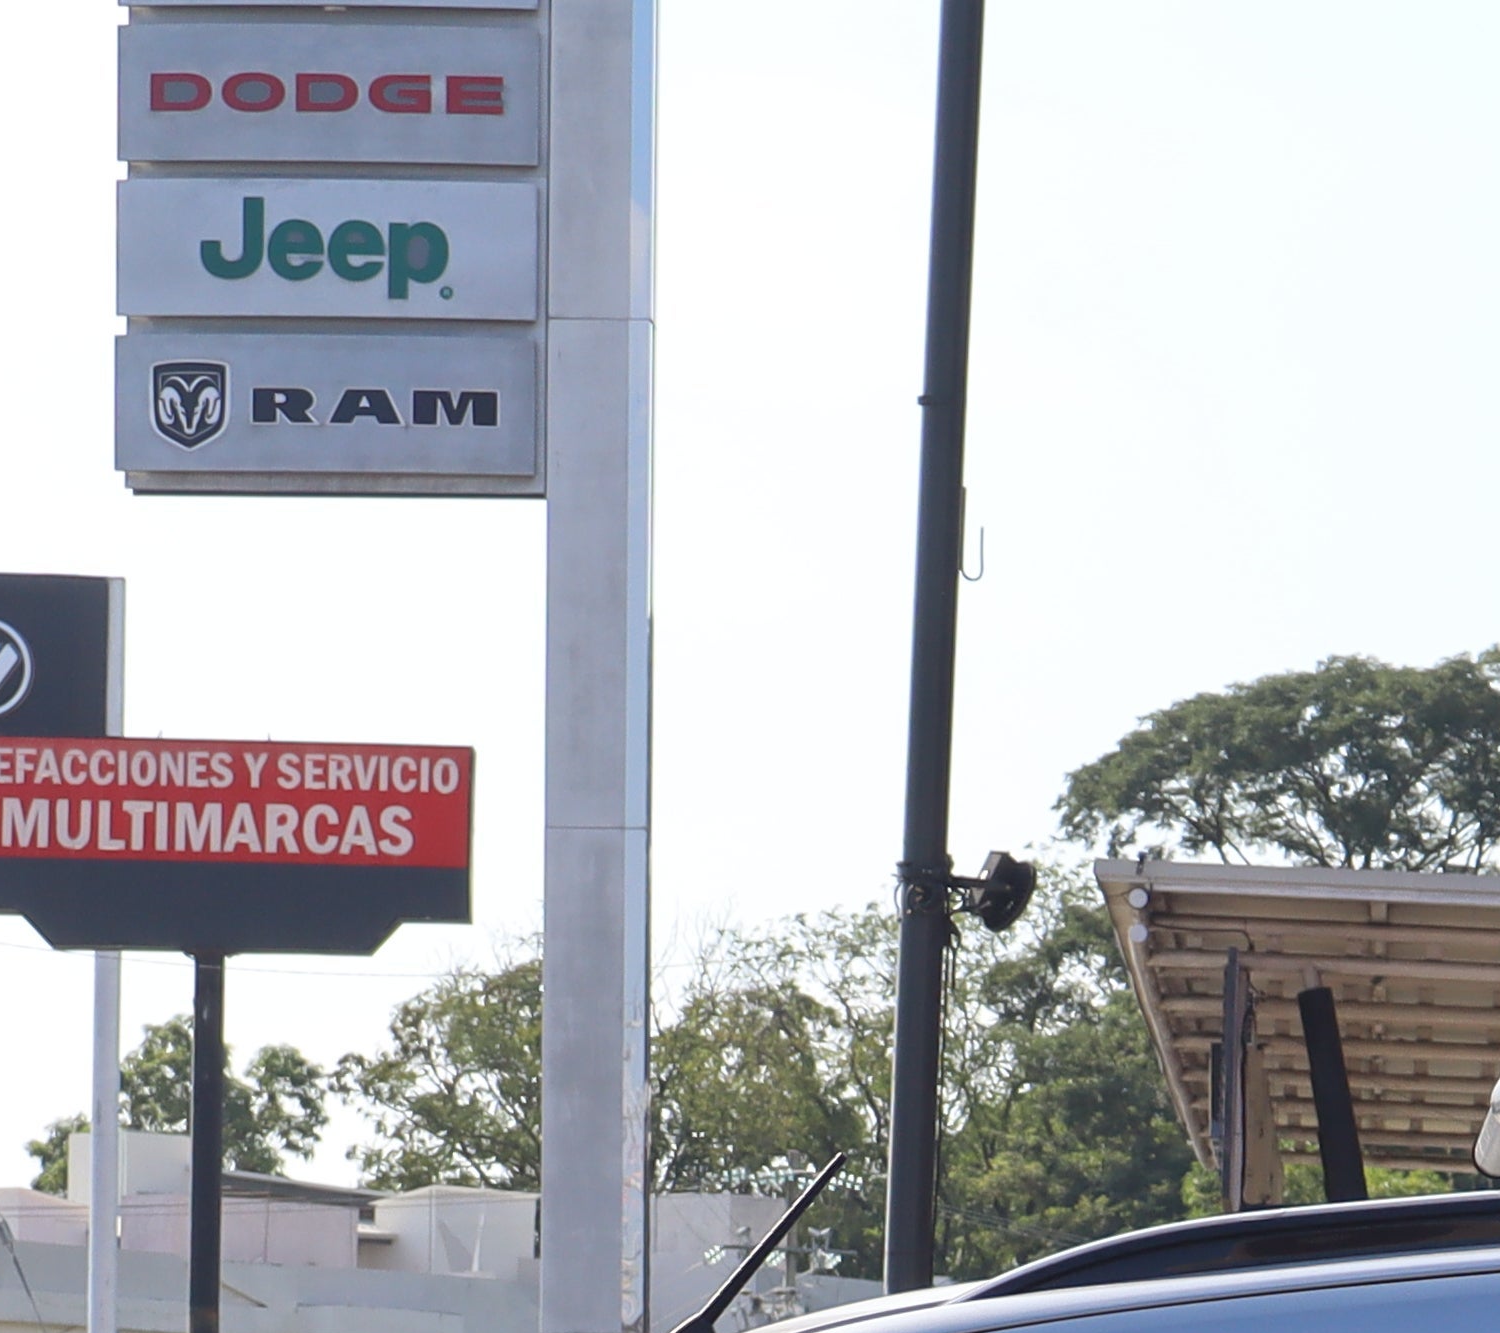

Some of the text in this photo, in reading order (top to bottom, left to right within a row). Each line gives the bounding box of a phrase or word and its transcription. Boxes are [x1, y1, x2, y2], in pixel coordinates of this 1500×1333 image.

[150, 72, 505, 115] DODGE
[200, 196, 450, 300] Jeep
[251, 387, 499, 428] RAM
[244, 755, 269, 789] Y
[277, 753, 460, 794] SERVICIO
[0, 797, 415, 857] MULTIMARCAS
